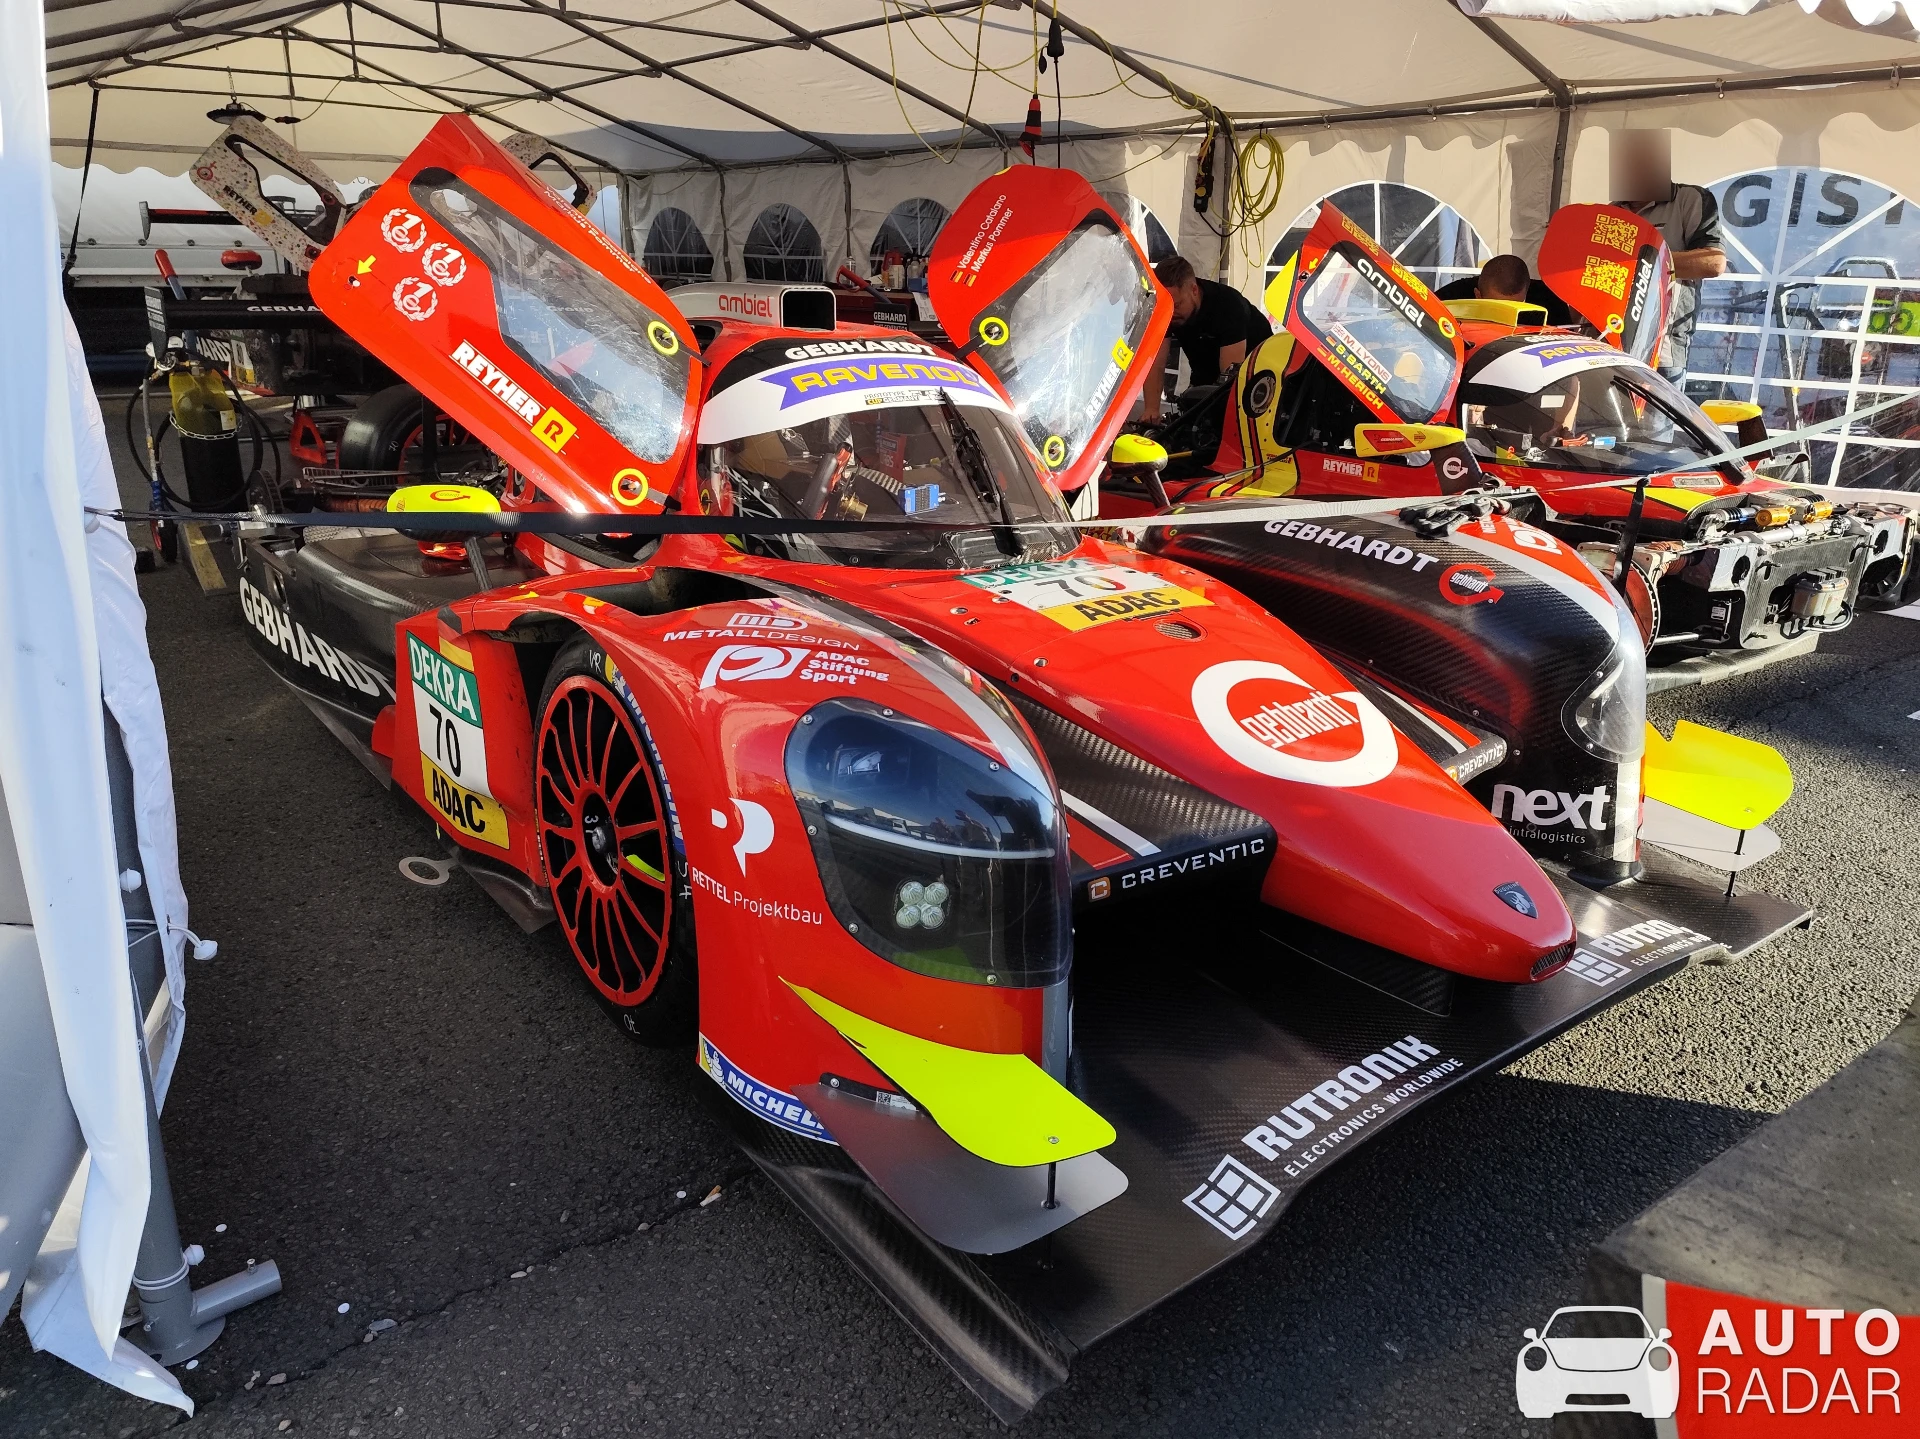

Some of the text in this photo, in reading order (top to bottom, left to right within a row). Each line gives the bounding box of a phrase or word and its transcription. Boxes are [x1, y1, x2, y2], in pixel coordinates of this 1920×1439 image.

[957, 194, 1006, 269] Valentino Catalano
[970, 207, 1014, 273] Markus Pommer
[718, 293, 773, 318] ambiel
[1357, 258, 1426, 328] ambiel
[1631, 258, 1653, 322] ambiel
[784, 340, 937, 361] GEBHARDT
[451, 341, 541, 423] REYHER
[790, 364, 980, 393] RAVENOL
[1085, 361, 1121, 420] REYHER
[1322, 458, 1363, 477] REYHER
[1263, 519, 1440, 573] GEBHARDT
[962, 558, 1100, 589] DEKRA
[1033, 574, 1127, 598] 70
[1450, 570, 1489, 595] gebhardt
[1073, 591, 1182, 622] ADAC
[239, 576, 396, 702] GEBHARDT
[662, 629, 860, 651] METALLDESIGN
[814, 650, 870, 666] ADAC
[408, 637, 478, 722] DEKRA
[799, 668, 857, 685] Sport
[807, 659, 890, 682] Stiftung
[429, 703, 462, 778] 70
[1240, 690, 1360, 749] gebhardt
[1459, 743, 1504, 779] CREVENTIC
[432, 767, 486, 834] ADAC
[1490, 783, 1611, 831] next
[1508, 825, 1587, 845] intralogistics
[1121, 838, 1265, 889] CREVENTIC
[692, 866, 823, 925] RETTEL Projektbau
[1241, 1034, 1441, 1162] RUTRONIK
[1283, 1057, 1464, 1178] ELECTRONICS WORLDWIDE
